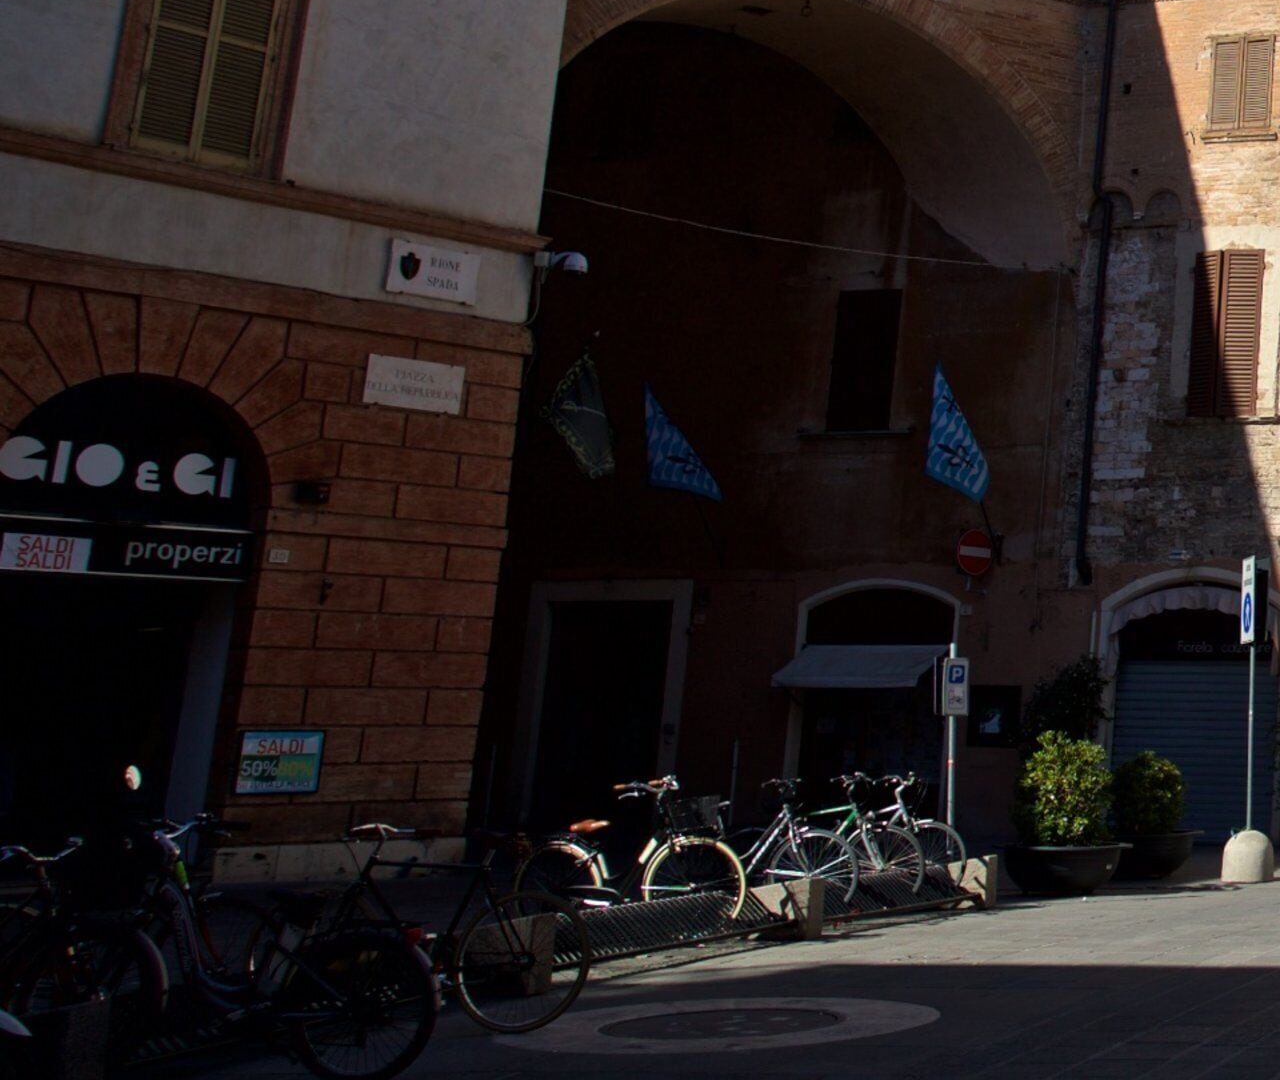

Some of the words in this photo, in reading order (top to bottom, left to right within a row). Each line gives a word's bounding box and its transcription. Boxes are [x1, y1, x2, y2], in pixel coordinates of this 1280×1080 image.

[430, 257, 462, 273] RIONE
[426, 276, 459, 292] SPADA
[394, 368, 435, 384] PIAZZA
[0, 435, 125, 488] GIO
[18, 535, 75, 554] SALDI
[15, 551, 73, 570] SALDI
[124, 539, 244, 569] properzi
[951, 666, 964, 682] P
[257, 738, 305, 754] SALDI
[240, 760, 277, 777] 50%
